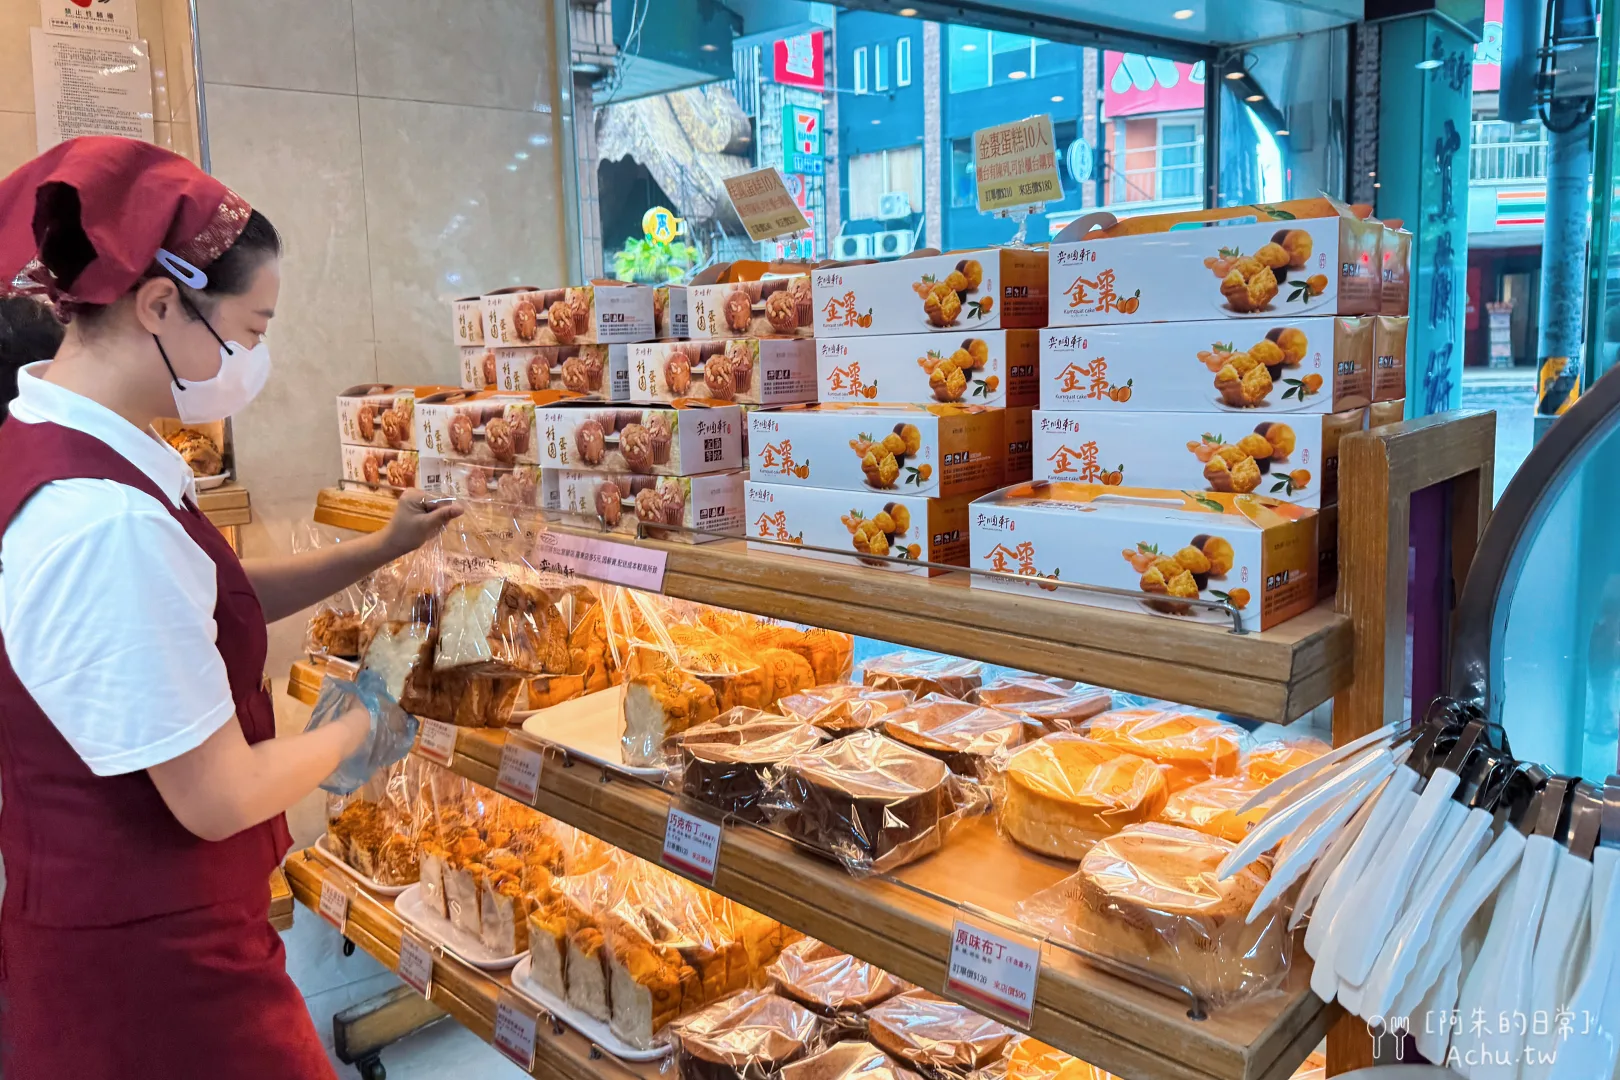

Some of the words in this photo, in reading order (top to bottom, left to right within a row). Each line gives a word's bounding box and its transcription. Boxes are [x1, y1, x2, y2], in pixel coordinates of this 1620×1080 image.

[821, 290, 858, 328] 金棗
[1063, 268, 1117, 314] 金棗
[826, 361, 863, 398] 金棗
[1054, 356, 1110, 401] 金棗
[758, 439, 795, 477] 金棗
[1047, 441, 1101, 484] 金棗
[984, 541, 1037, 580] 金棗
[669, 813, 702, 835] 巧克布丁
[956, 928, 1008, 959] 原味布丁
